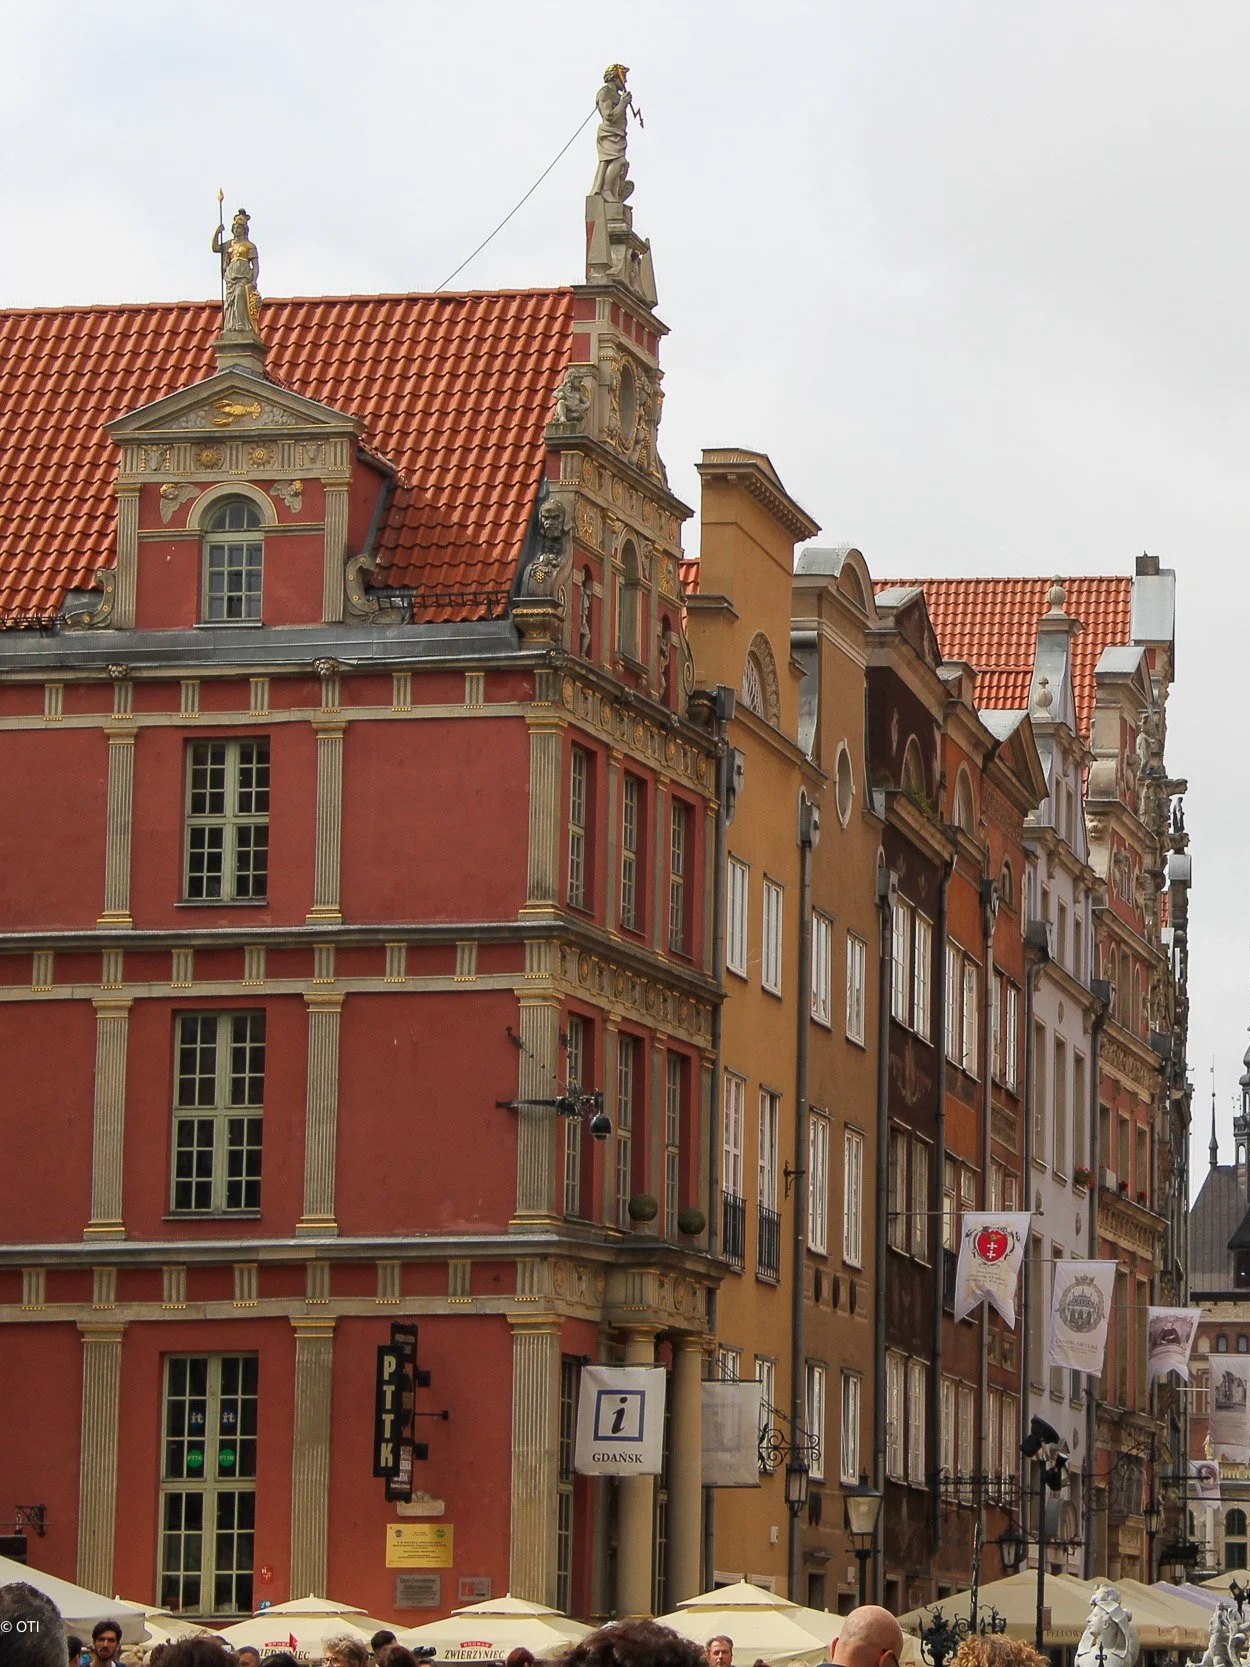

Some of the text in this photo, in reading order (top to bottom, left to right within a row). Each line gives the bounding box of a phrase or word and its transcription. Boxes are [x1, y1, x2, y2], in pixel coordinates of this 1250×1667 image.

[221, 1411, 236, 1423] it
[380, 1355, 397, 1468] PTTK
[592, 1450, 644, 1464] GDAŃSK
[443, 1649, 506, 1660] ZWIERZYNIEC
